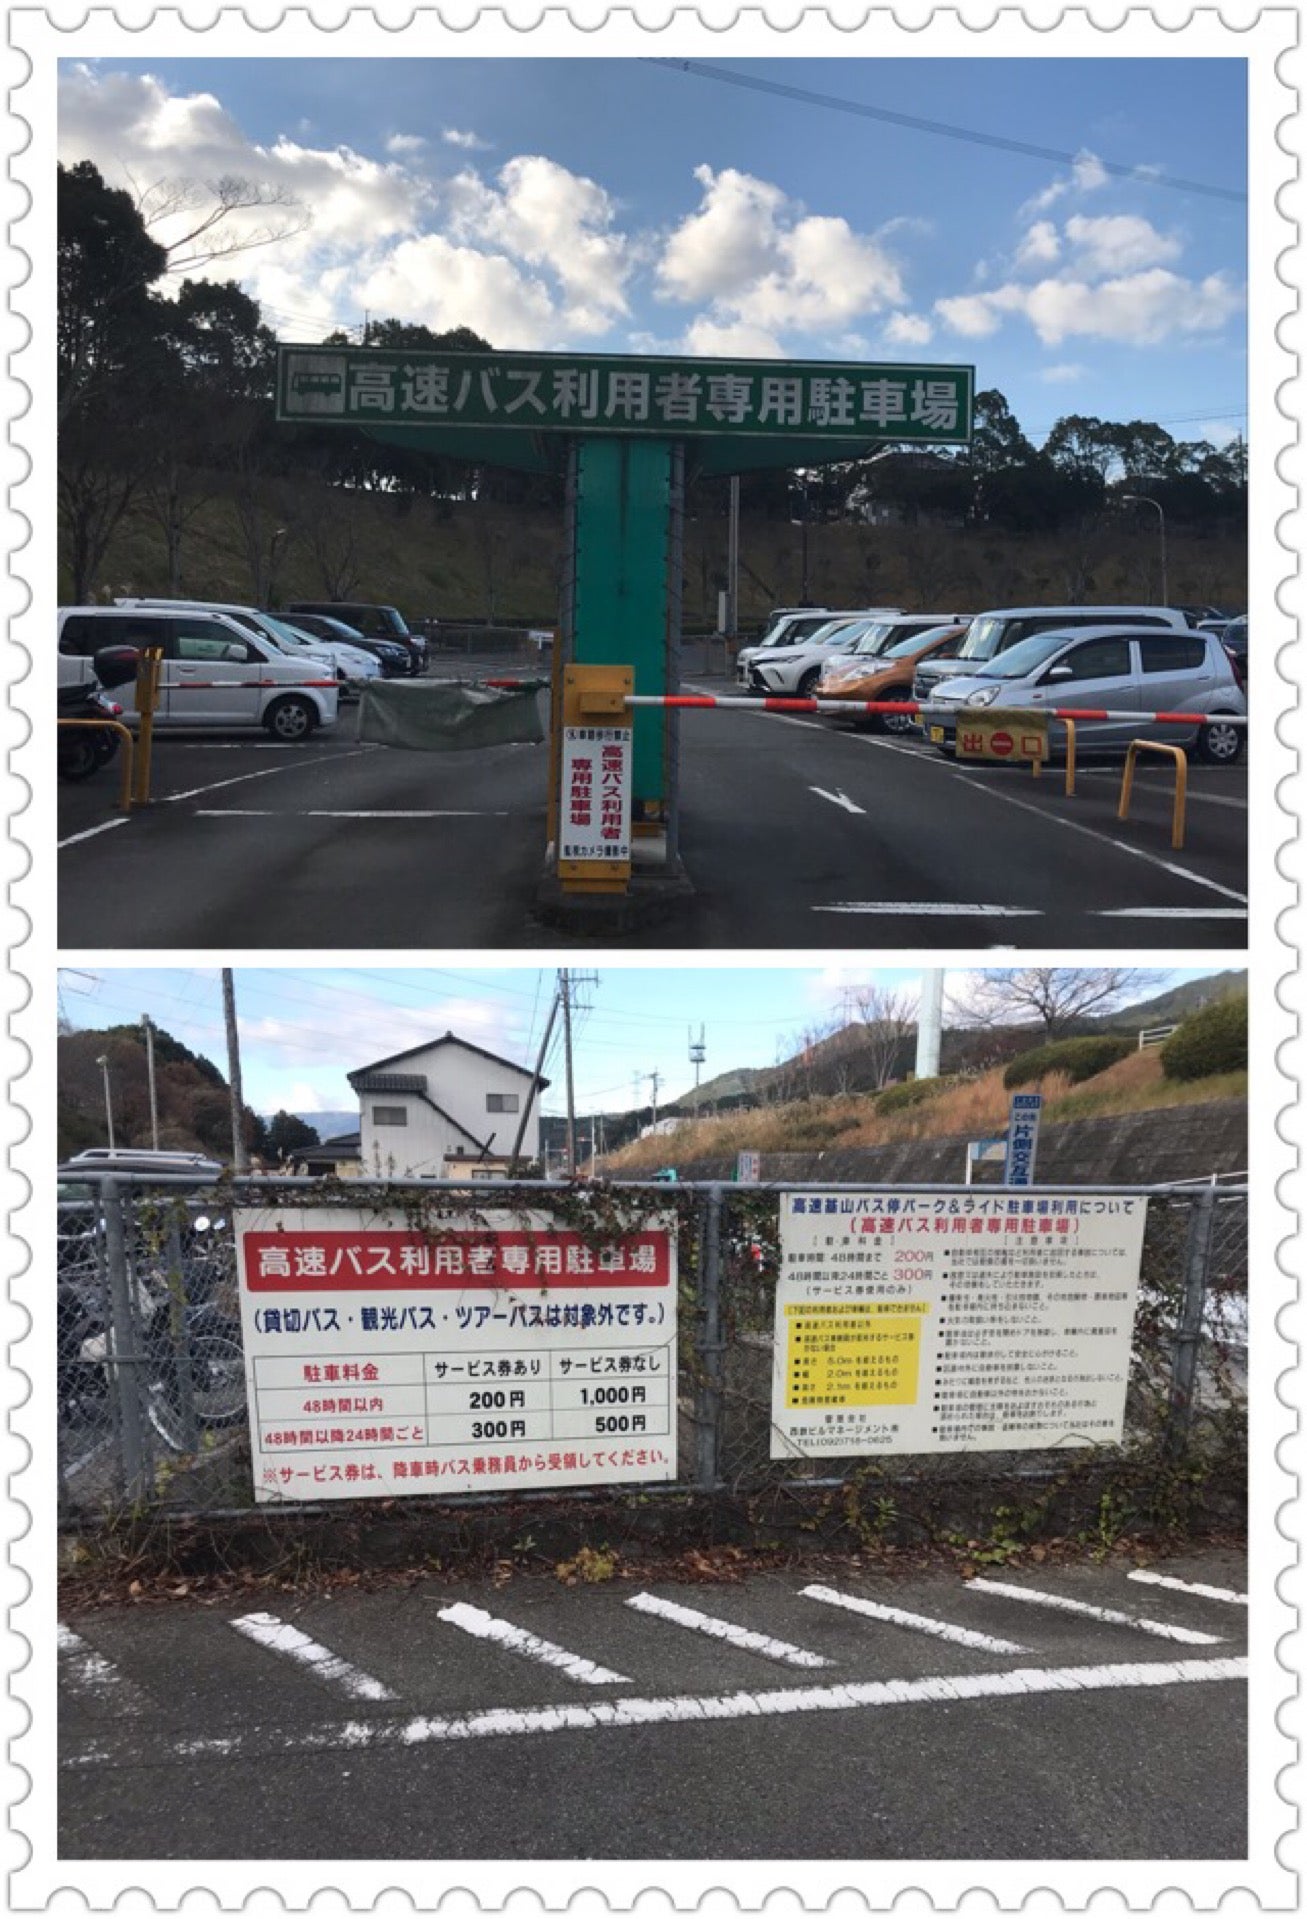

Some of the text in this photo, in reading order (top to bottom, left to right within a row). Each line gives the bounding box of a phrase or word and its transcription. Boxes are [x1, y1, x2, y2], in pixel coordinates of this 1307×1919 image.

[348, 362, 957, 429] 高速バス利用者専用駐車場
[964, 731, 983, 752] 出
[1022, 736, 1042, 755] 口
[570, 758, 592, 825] 専用駐車場
[601, 745, 623, 839] 高速バス利用者
[791, 1197, 1135, 1215] 高速基山バス停パーク&ライド駐車場利用について
[258, 1245, 657, 1277] 高速バス利用者専用駐車場
[894, 1249, 934, 1263] 200円
[893, 1268, 933, 1281] 300円
[254, 1302, 665, 1334] (貸切バス・観光バス・ツアーバスは対象外です。)
[303, 1355, 661, 1383] 駐車料金 サービス券あり サービス券なし
[302, 1386, 646, 1414] 48時間以内 200円 1,000円
[264, 1414, 646, 1446] 48時間以降24時間ごと 300円 500円
